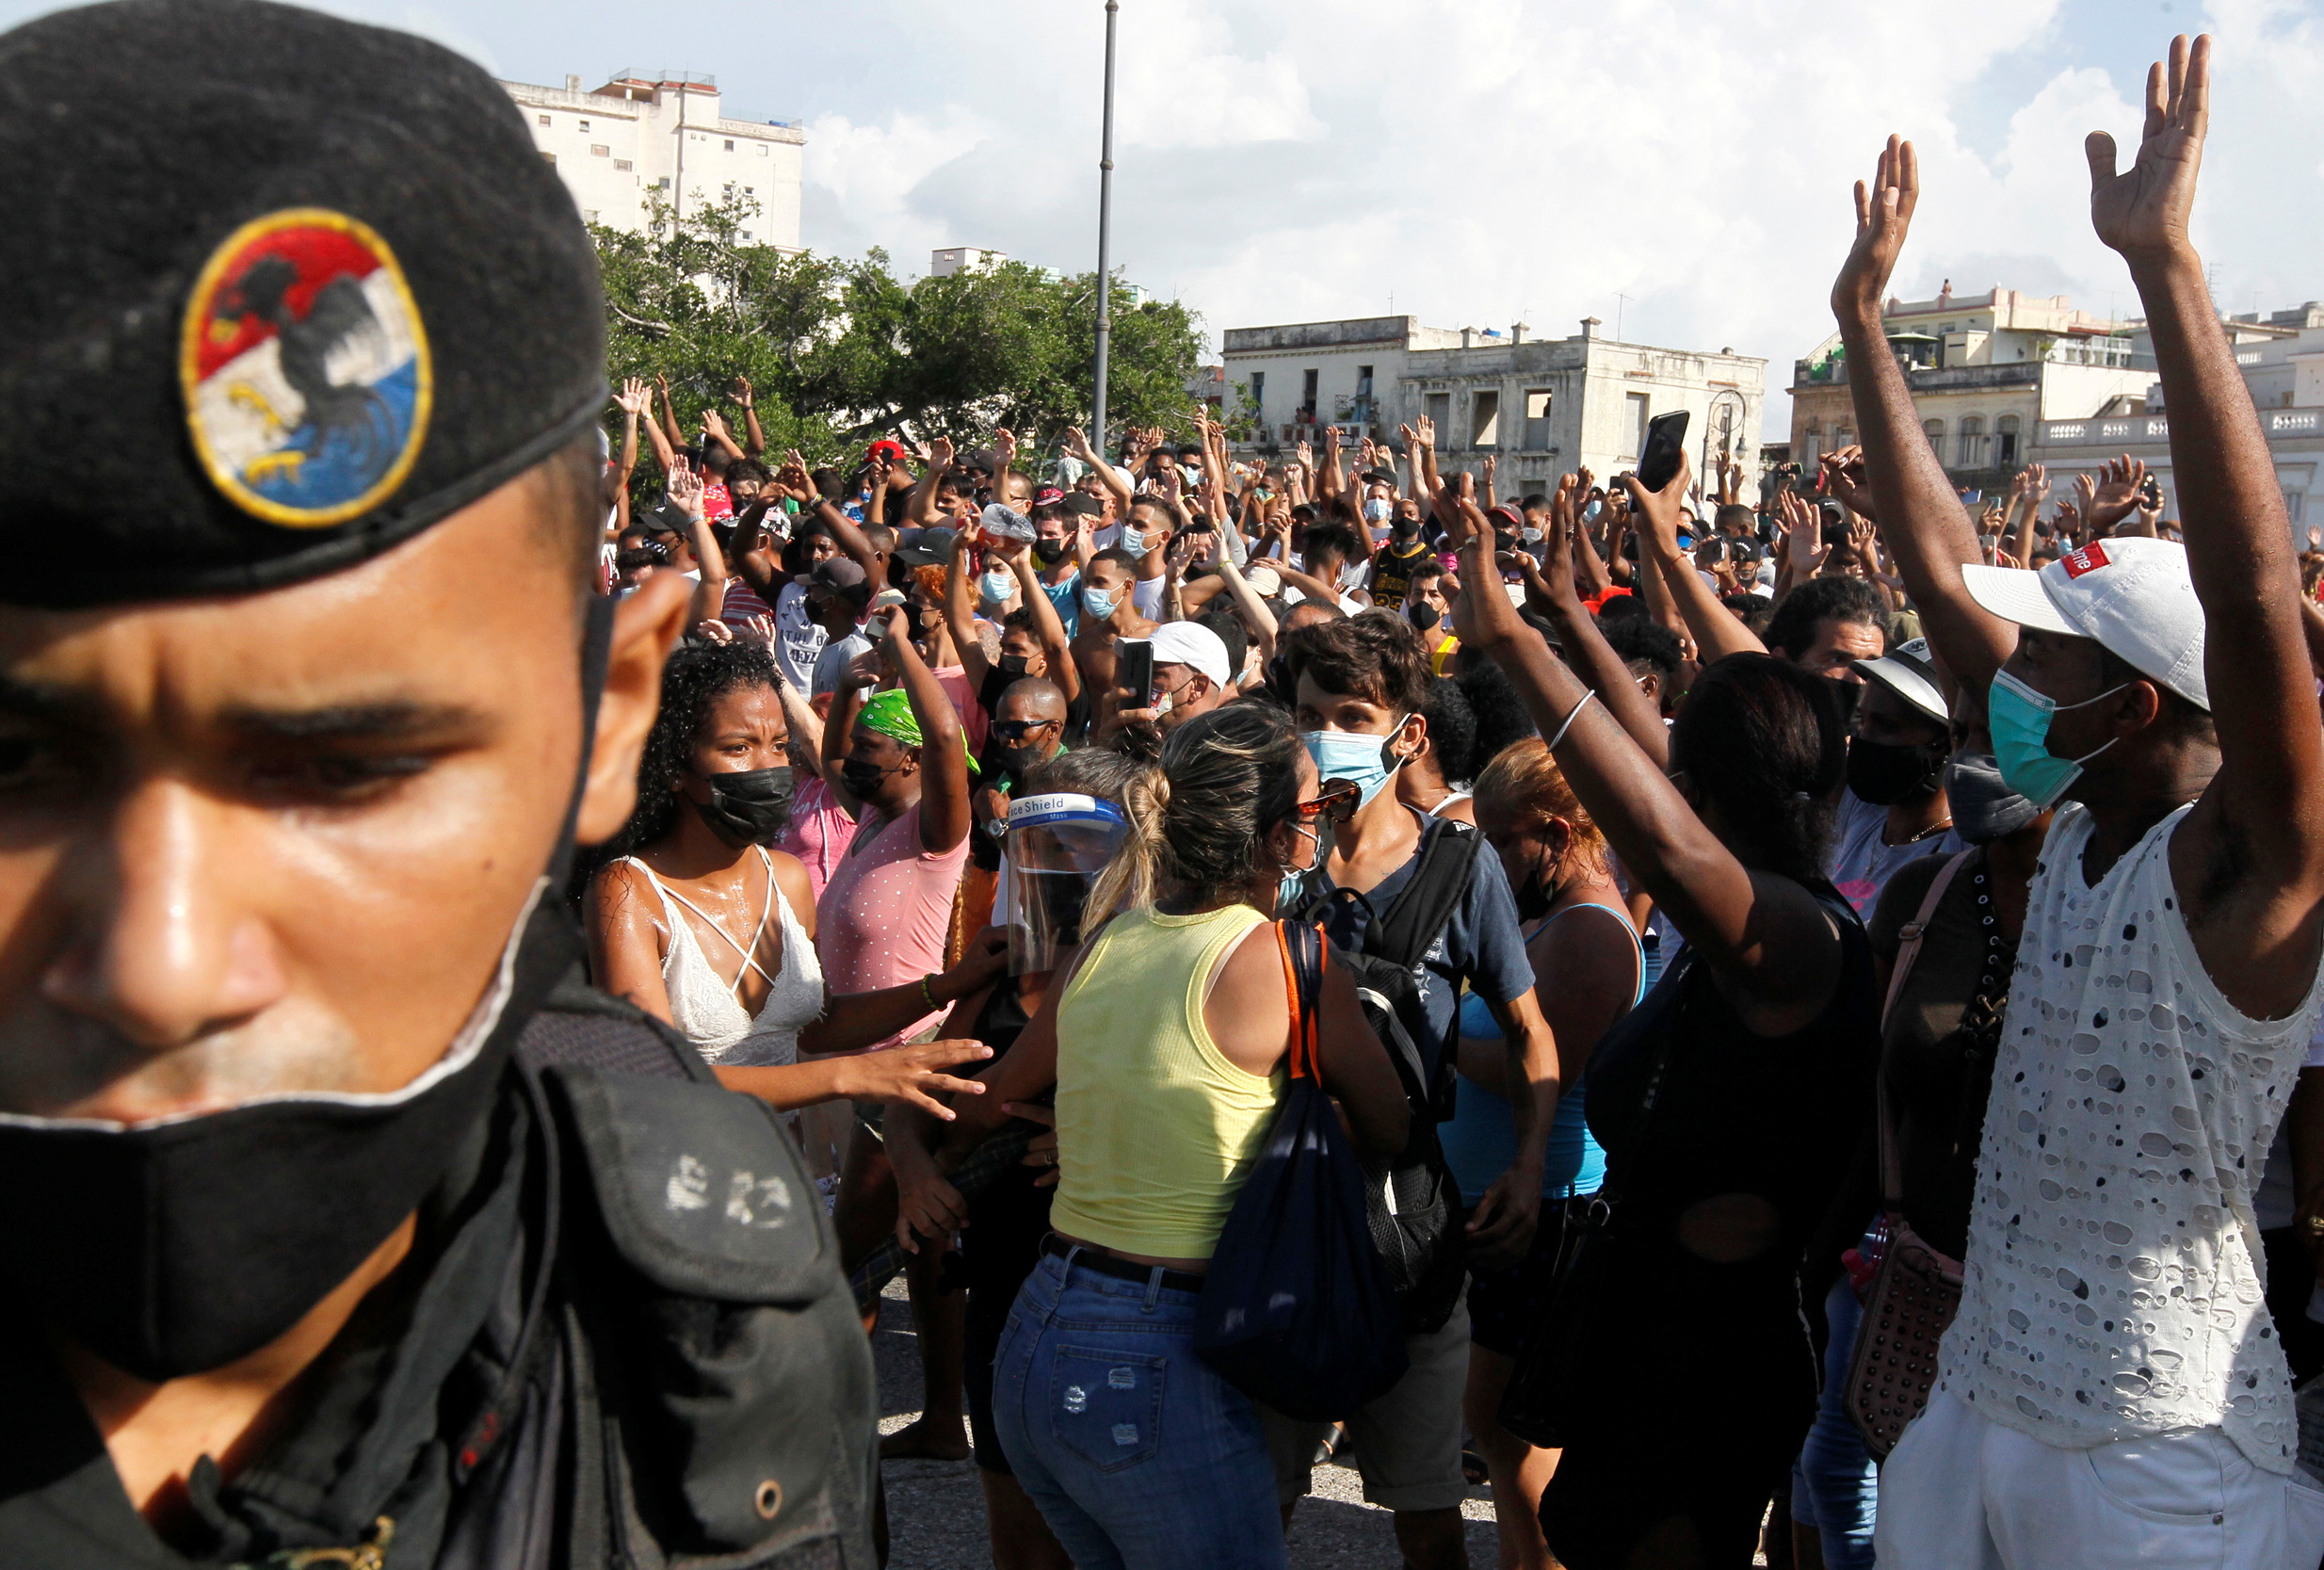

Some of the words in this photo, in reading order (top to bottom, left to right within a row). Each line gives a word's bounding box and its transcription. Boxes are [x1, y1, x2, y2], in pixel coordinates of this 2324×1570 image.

[2071, 547, 2091, 569] eme
[1009, 806, 1024, 817] ace
[1025, 797, 1064, 814] Shield
[1049, 812, 1069, 820] Mask
